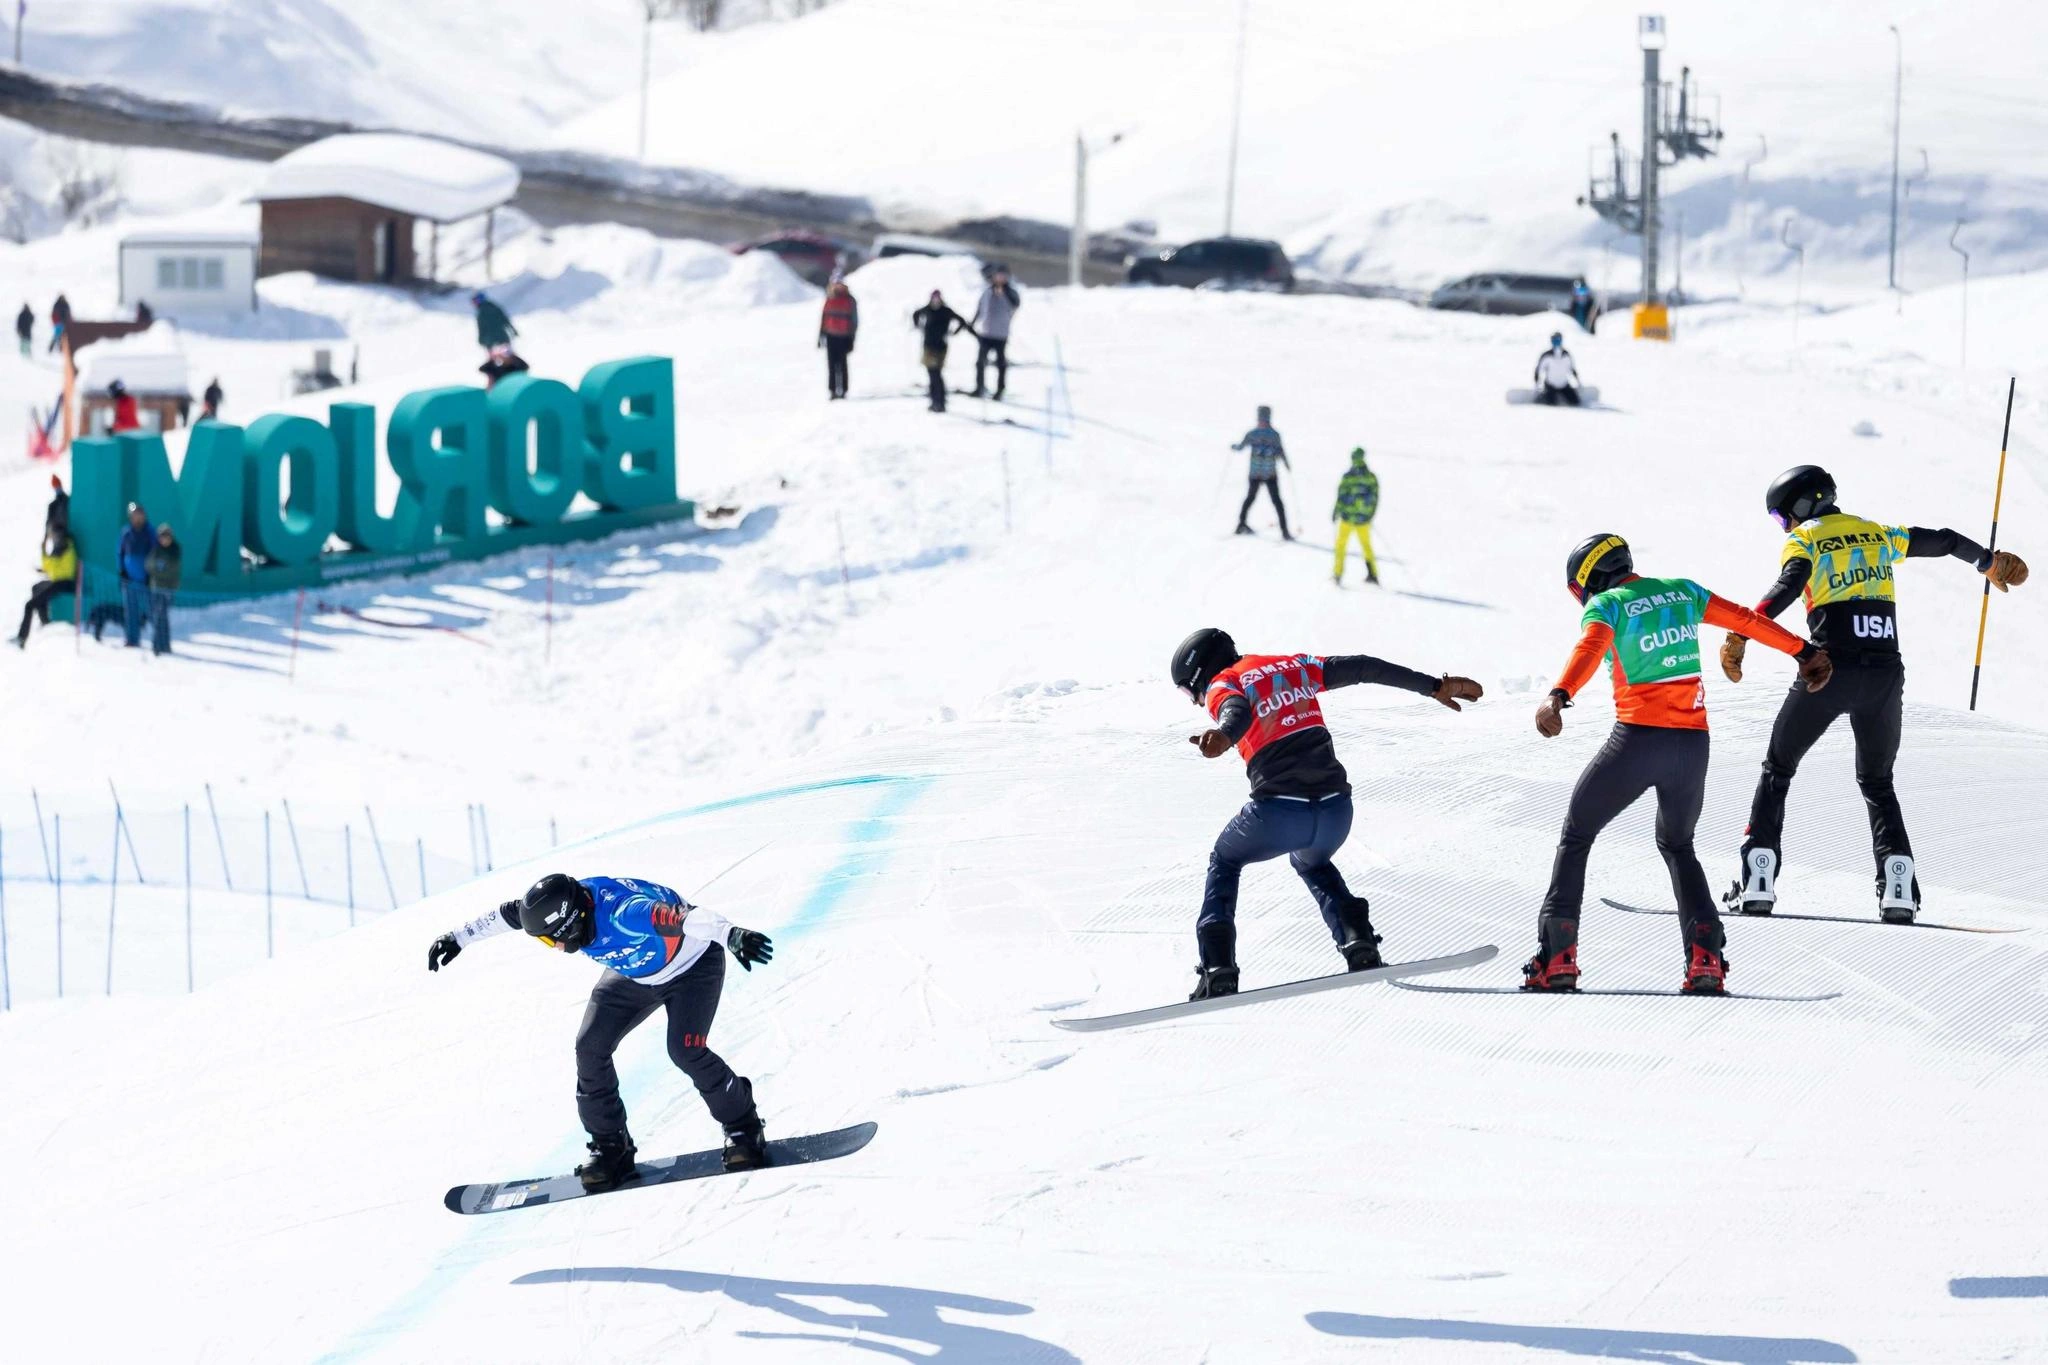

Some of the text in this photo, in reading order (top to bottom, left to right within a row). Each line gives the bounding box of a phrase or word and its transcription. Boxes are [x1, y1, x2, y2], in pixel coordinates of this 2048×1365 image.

[1639, 623, 1699, 653] GUDAU
[1853, 615, 1895, 639] USA
[1256, 686, 1316, 718] GUDAU
